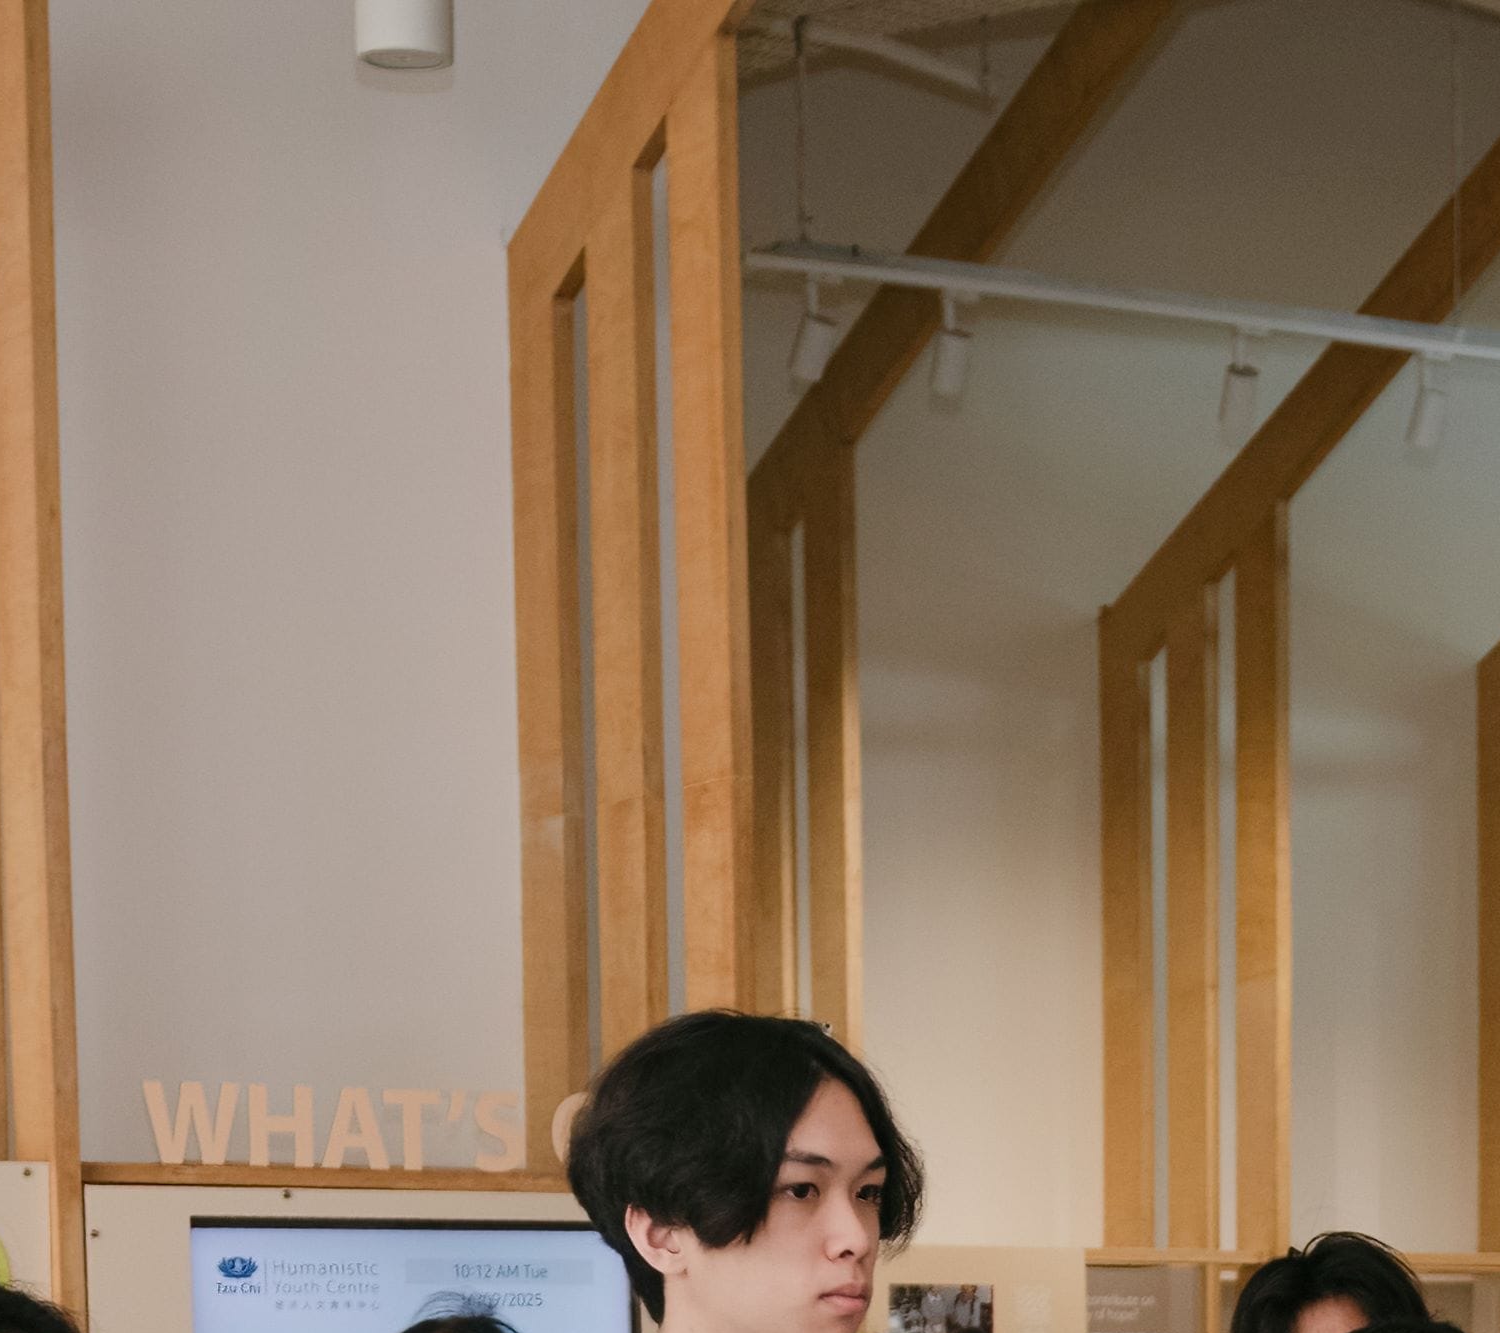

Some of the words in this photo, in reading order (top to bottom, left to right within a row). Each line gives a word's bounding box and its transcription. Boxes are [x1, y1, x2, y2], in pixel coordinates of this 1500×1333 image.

[142, 1079, 520, 1172] WHAT'S
[272, 1260, 379, 1275] Humanistic
[497, 1265, 519, 1278] AM
[524, 1264, 548, 1279] Tue
[216, 1282, 237, 1294] Tzu
[241, 1282, 261, 1294] Chi
[274, 1280, 320, 1294] Youth
[326, 1280, 380, 1294] Centre
